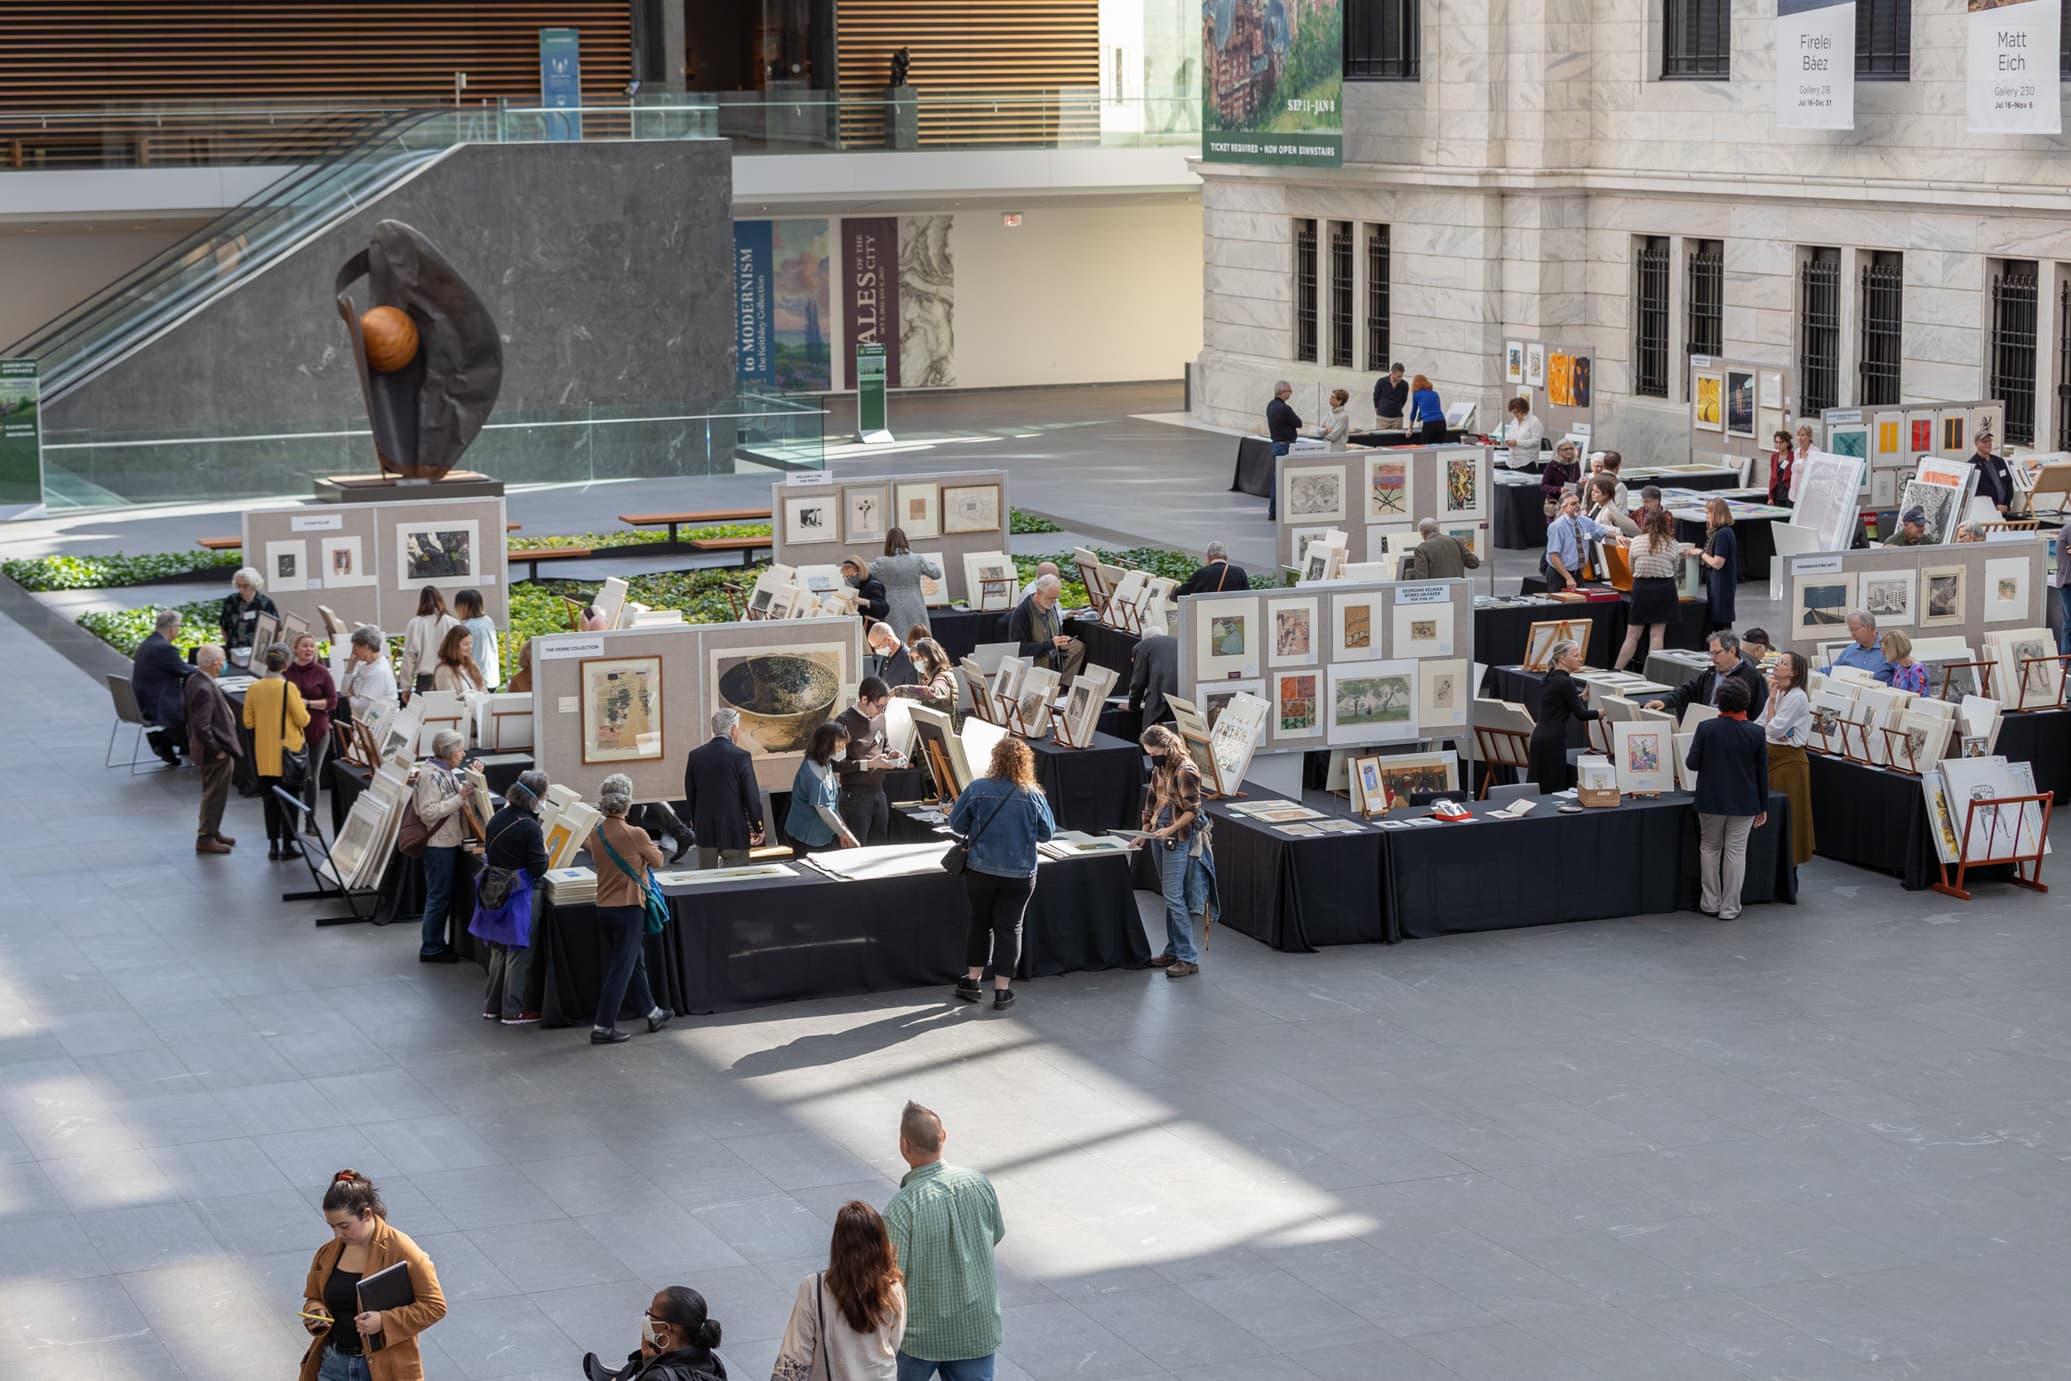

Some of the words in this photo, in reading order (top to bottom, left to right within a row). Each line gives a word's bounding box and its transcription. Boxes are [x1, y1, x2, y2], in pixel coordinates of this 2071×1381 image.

[1800, 34, 1832, 50] Firelei
[1998, 32, 2027, 48] Matt
[1802, 56, 1828, 71] Báez
[1998, 54, 2026, 71] Eich
[1800, 85, 1820, 96] Gallery
[1994, 86, 2018, 98] Gallery
[2020, 86, 2035, 96] 230
[1288, 99, 1302, 112] SEP
[1330, 100, 1335, 112] 8
[1210, 142, 1230, 152] TICKET
[1231, 143, 1259, 153] REQUIRED
[1264, 145, 1277, 154] NOW
[1279, 146, 1297, 155] OPEN
[866, 235, 876, 270] CITY
[856, 258, 863, 270] OF
[740, 248, 755, 353] MODERNISM
[756, 275, 766, 320] Collection
[856, 272, 877, 344] ALES
[758, 322, 767, 356] Keithley
[744, 357, 755, 372] to
[758, 357, 767, 371] the
